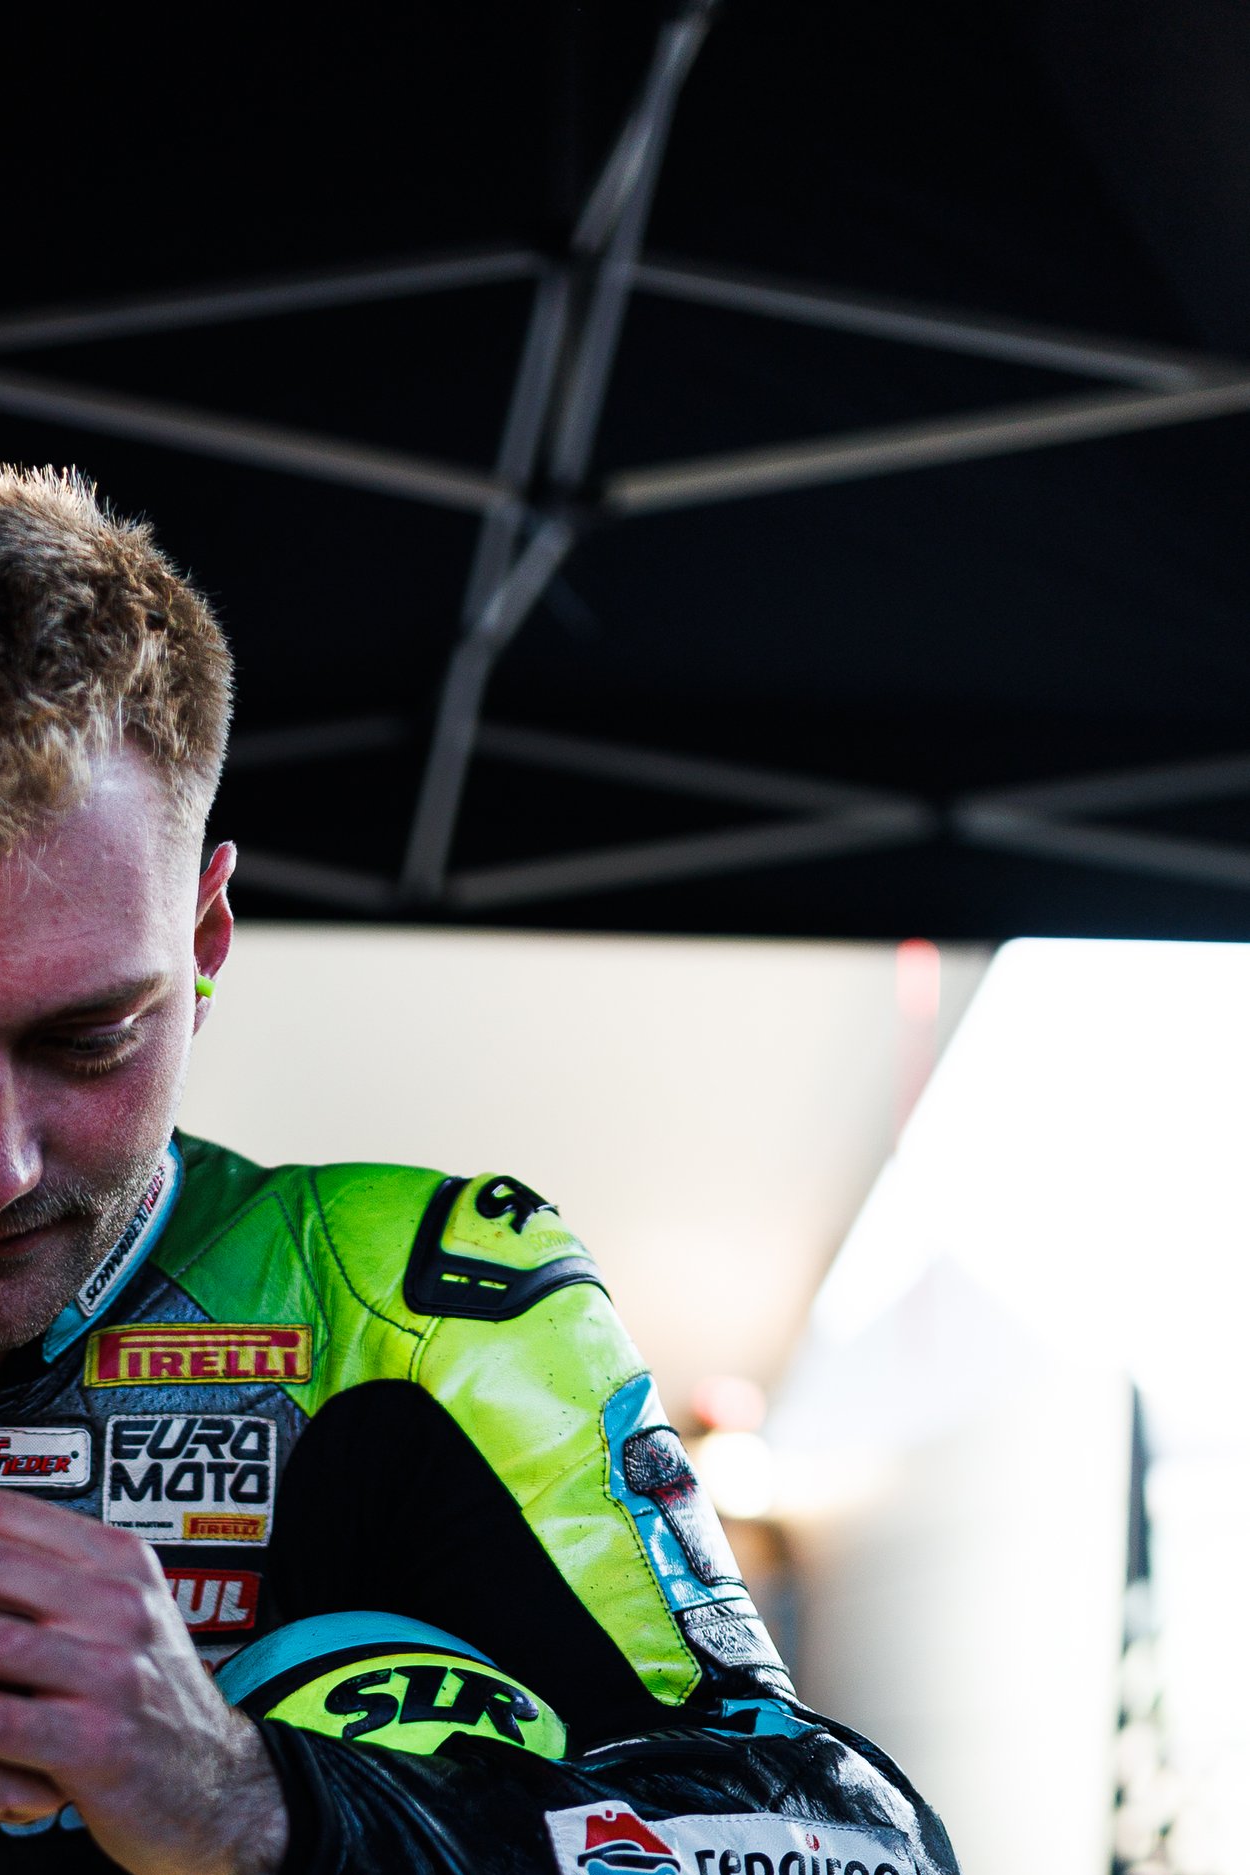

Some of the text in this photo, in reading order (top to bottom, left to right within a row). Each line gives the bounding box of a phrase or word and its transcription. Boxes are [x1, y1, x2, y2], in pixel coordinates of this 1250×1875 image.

[98, 1329, 300, 1380] PIRELLI
[111, 1419, 270, 1461] EURO
[111, 1461, 270, 1504] MOTO
[135, 1520, 174, 1529] PARTNER
[190, 1517, 261, 1536] PIRELLI
[324, 1665, 539, 1740] SLR
